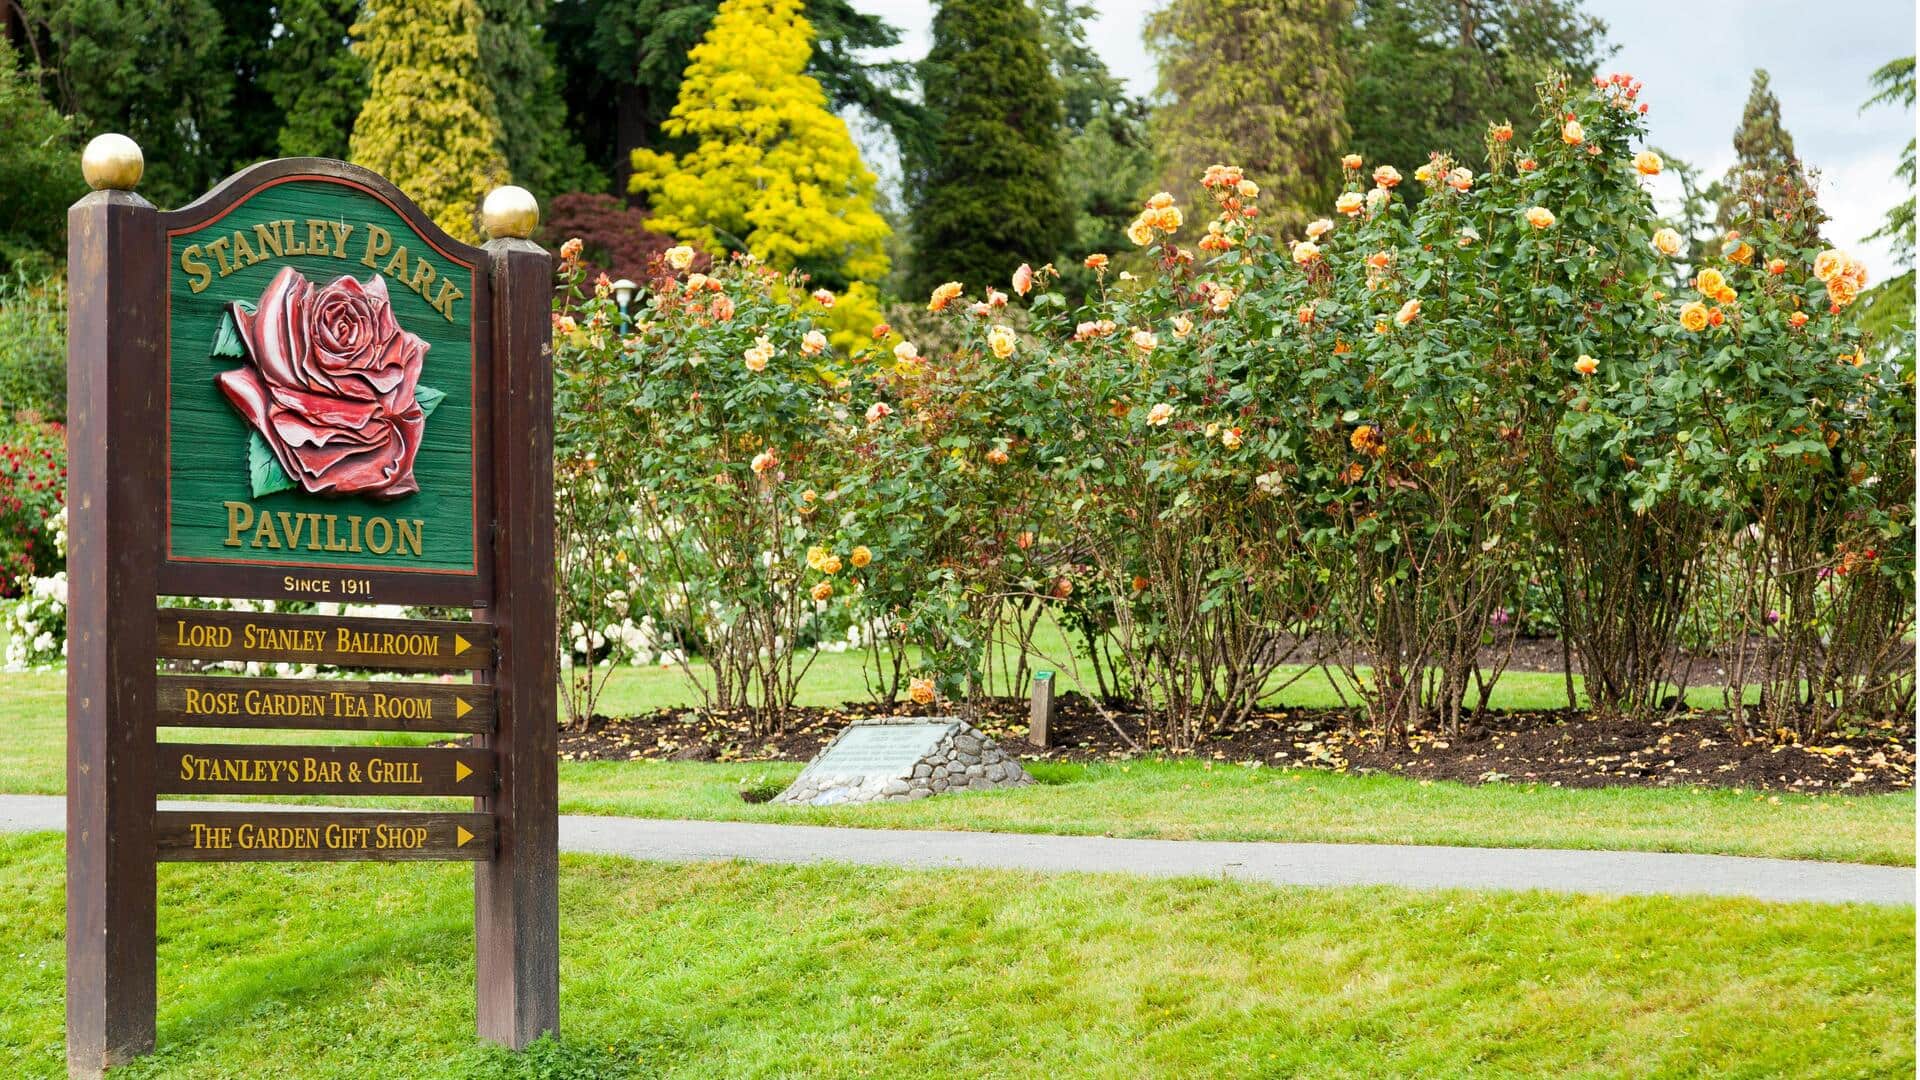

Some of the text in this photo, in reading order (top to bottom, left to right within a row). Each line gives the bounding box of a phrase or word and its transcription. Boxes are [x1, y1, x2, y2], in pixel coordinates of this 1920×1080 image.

[181, 219, 464, 322] STANLEY PARK
[223, 501, 424, 556] PAVILION
[284, 576, 371, 594] SINCE 1911
[177, 620, 440, 656] LORD STANLEY BALLROOM
[185, 688, 433, 719] ROSE GARDEN TEA ROOM
[180, 754, 423, 784] STANLEY'S BAR & GRILL
[190, 823, 428, 849] THE GARDEN GIFT SHOP
